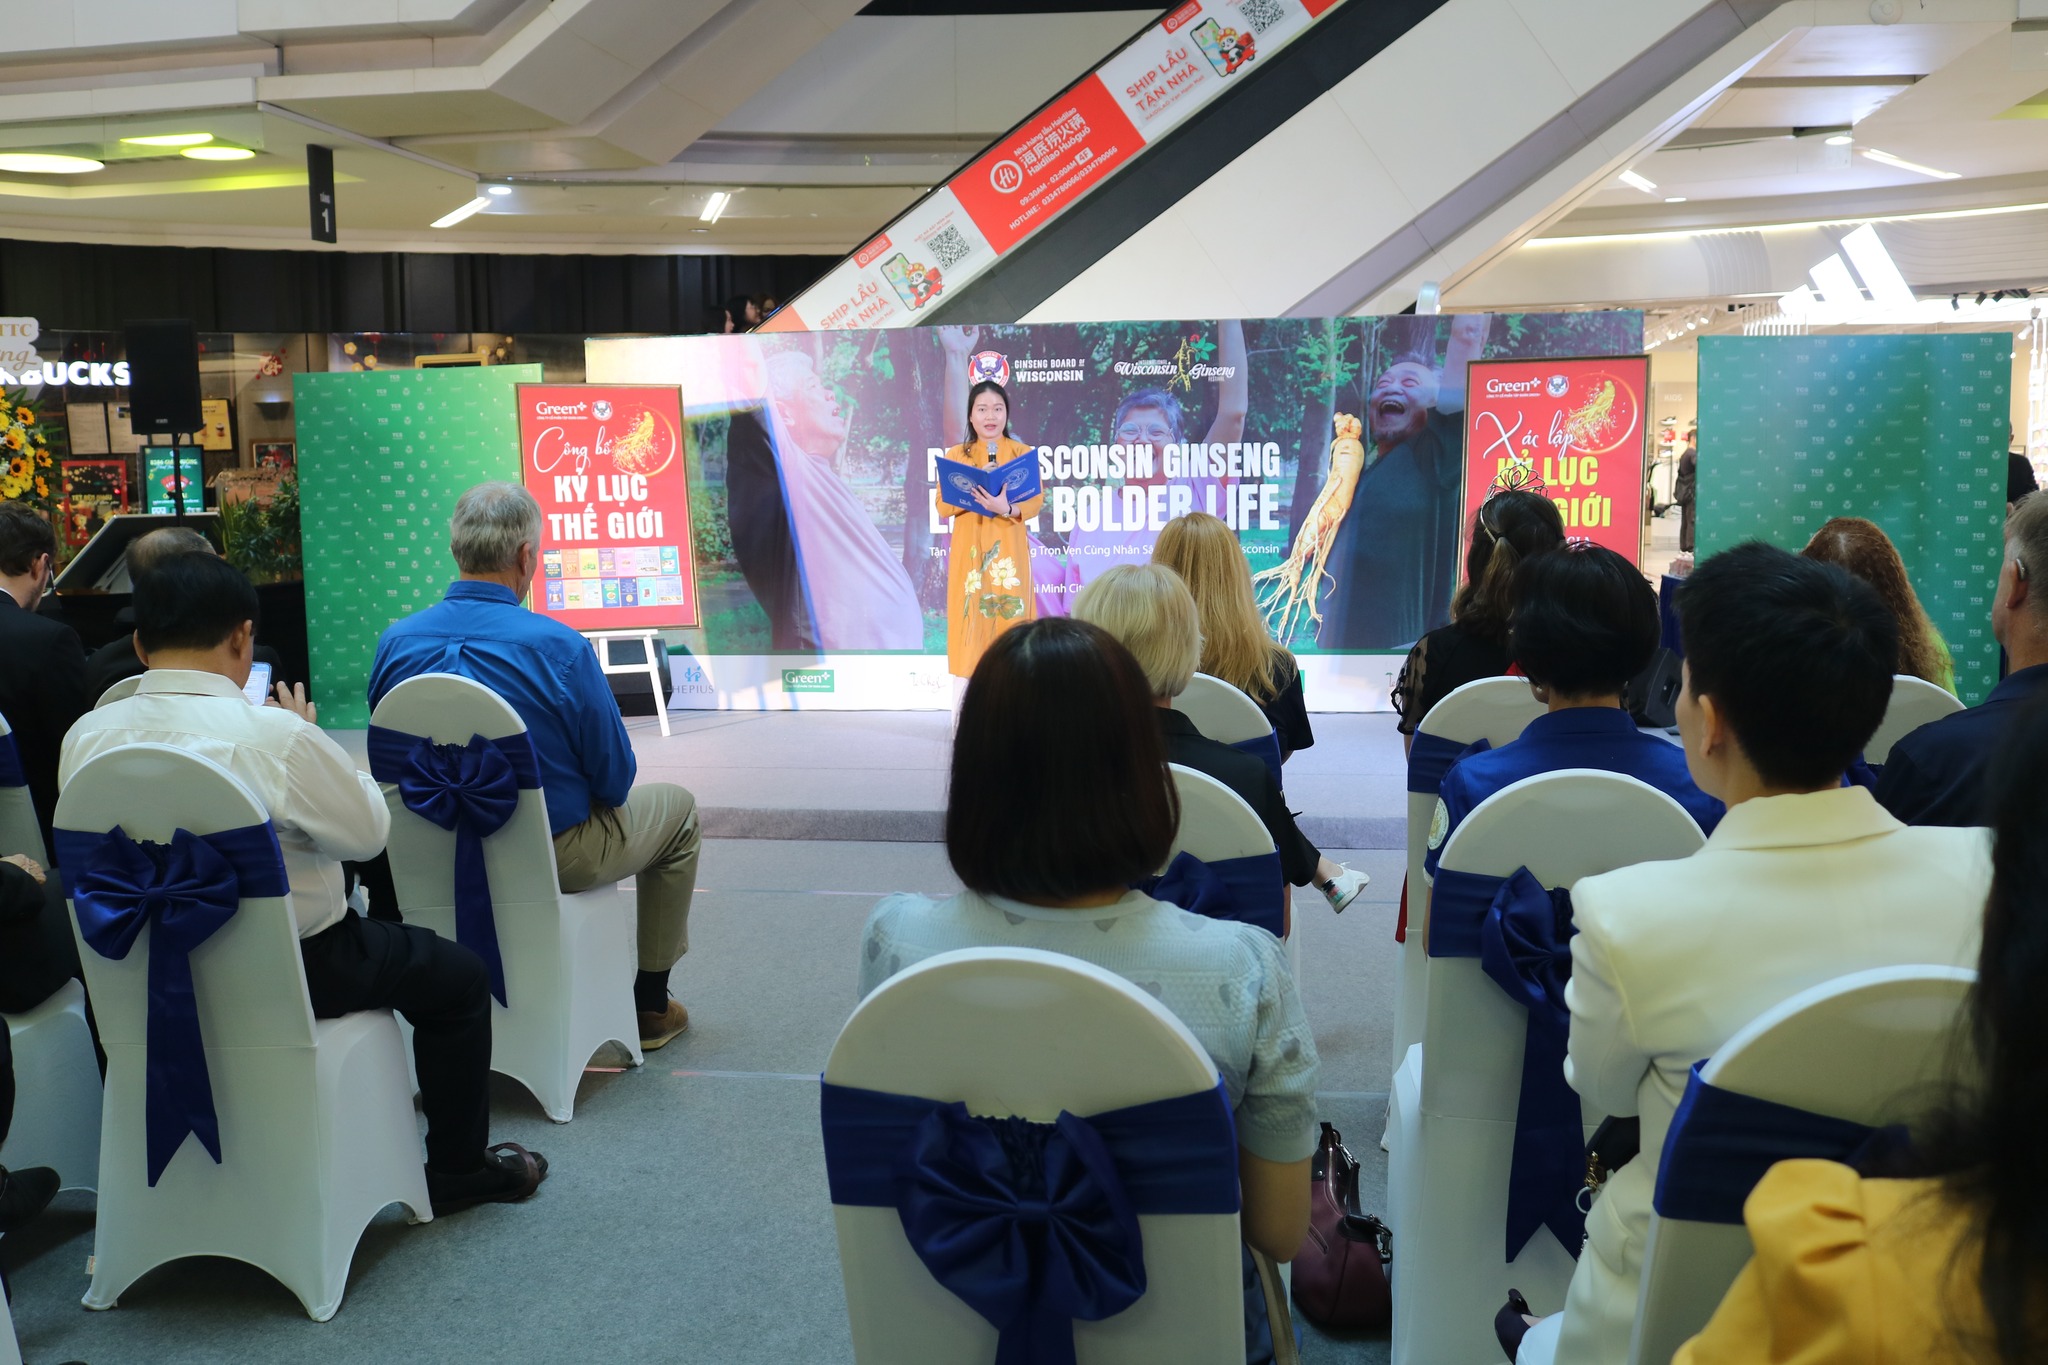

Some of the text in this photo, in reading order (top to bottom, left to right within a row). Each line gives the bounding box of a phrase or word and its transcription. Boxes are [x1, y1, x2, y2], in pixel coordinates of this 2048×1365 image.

[1126, 48, 1188, 98] SHIP LẨU
[1135, 62, 1198, 111] TẬN NHÀ
[1014, 144, 1028, 156] Nhà
[1026, 134, 1043, 146] hàng
[1051, 107, 1076, 128] Haidilao
[1019, 113, 1086, 168] 海底捞火锅
[1027, 150, 1060, 176] Haidilao
[1079, 151, 1090, 161] 4F
[1020, 183, 1048, 206] 09:30AM
[1050, 161, 1077, 183] 02:00AM
[322, 208, 329, 232] 1
[1009, 204, 1040, 230] HOTLINE:
[820, 304, 849, 329] SHIP
[859, 295, 889, 320] NHÀ
[0, 361, 131, 386] BUCKS
[1015, 359, 1048, 369] GINSENG
[1051, 359, 1076, 368] BOARD
[1016, 370, 1084, 382] WISCONSIN
[1114, 361, 1235, 379] Wisconsin Ginseng
[533, 426, 613, 475] Công bố
[1476, 410, 1575, 465] Xác lập
[1038, 442, 1280, 480] SCONSIN GINSENG
[1544, 456, 1598, 492] LỤC
[598, 474, 648, 507] LỤC
[1053, 485, 1192, 532] BOLDER
[548, 503, 664, 541] THẾ GIỚI
[929, 547, 946, 558] Tận
[1039, 546, 1061, 557] Trọn
[1063, 546, 1081, 557] Vẹn
[1084, 545, 1110, 557] Cùng
[1113, 545, 1142, 555] Nhân
[1143, 545, 1153, 555] Sâ
[1042, 584, 1066, 593] Minh
[1069, 584, 1084, 593] Cit
[672, 685, 714, 693] HEPIUS
